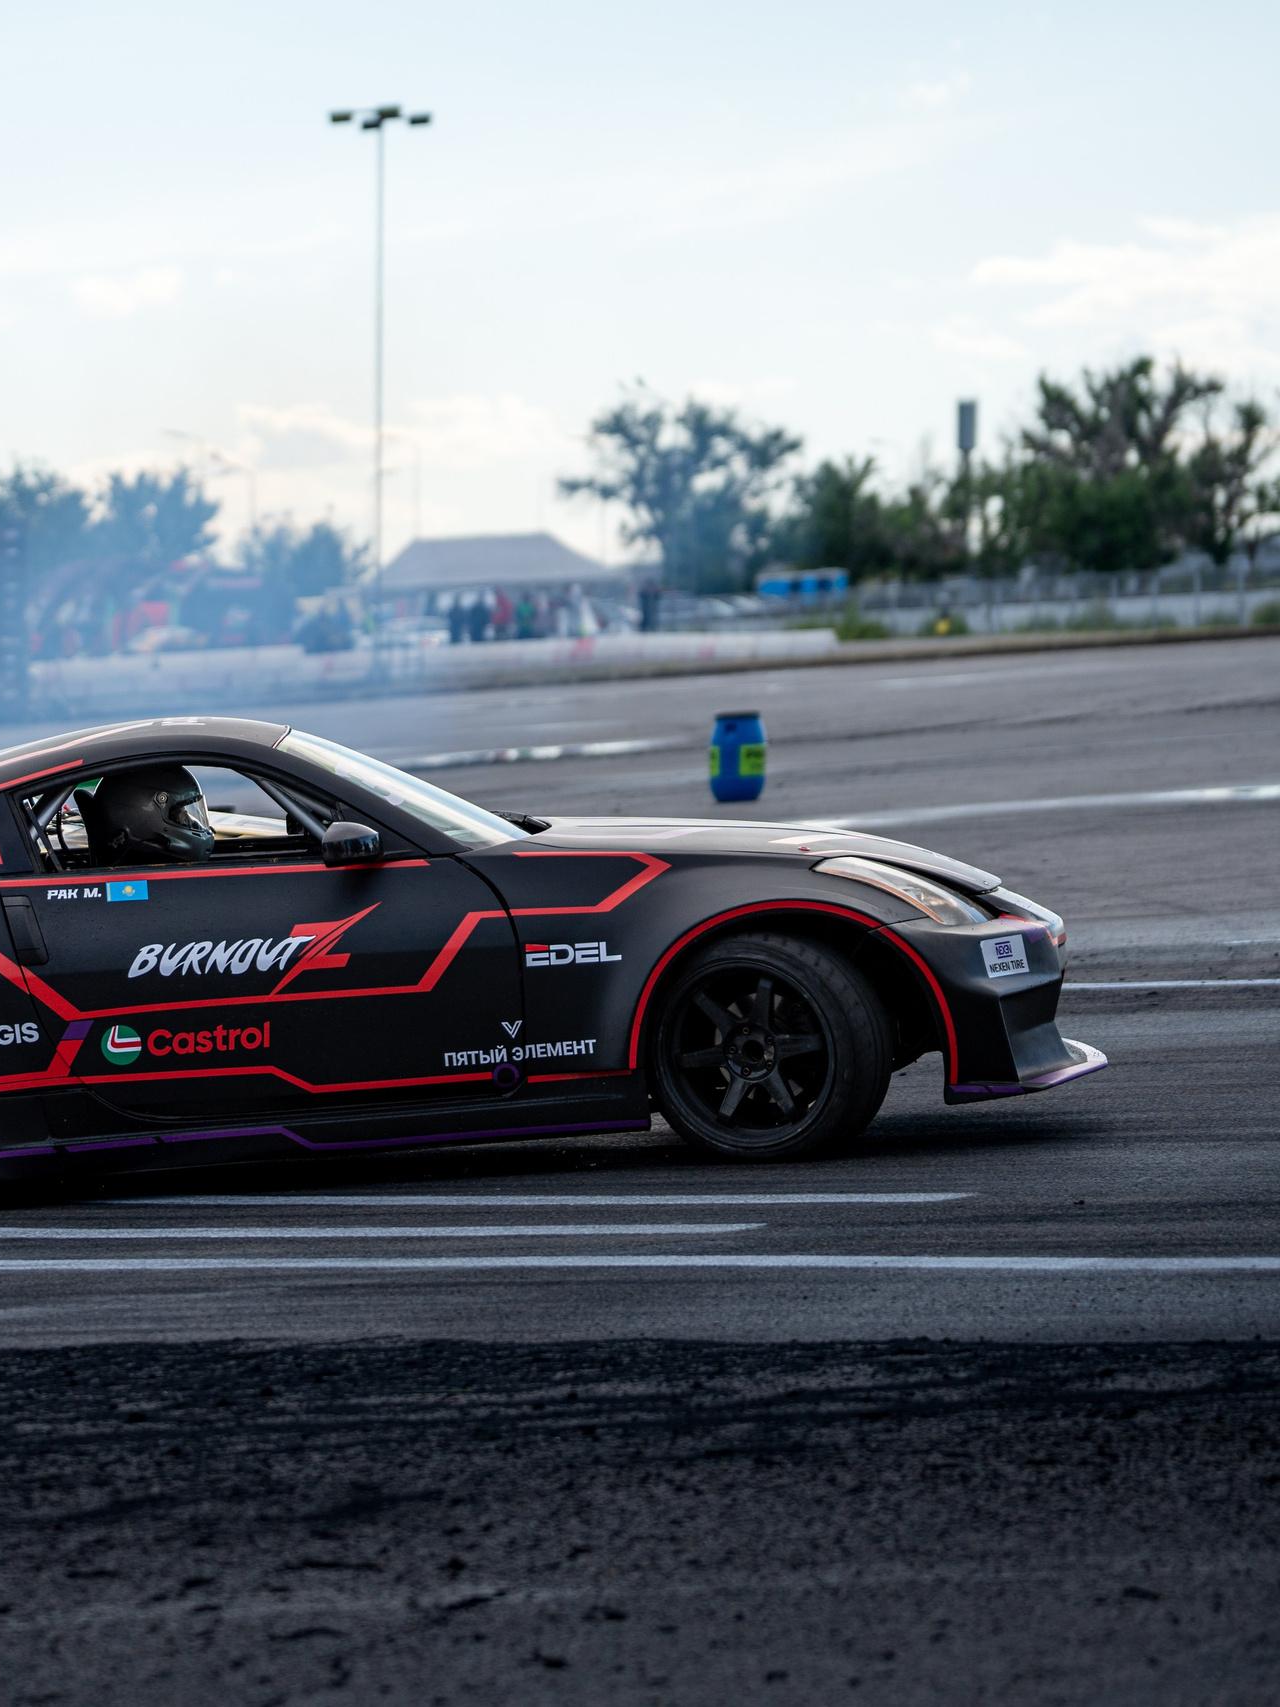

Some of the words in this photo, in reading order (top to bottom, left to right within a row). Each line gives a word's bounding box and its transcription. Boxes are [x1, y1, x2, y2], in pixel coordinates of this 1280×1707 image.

[47, 888, 79, 900] PAK
[83, 887, 102, 898] M.
[525, 941, 623, 967] EDEL
[989, 962, 1011, 973] NEXEN
[1010, 959, 1025, 970] TIRE
[147, 1020, 271, 1056] Castrol
[444, 1045, 508, 1067] ПЯТЫЙ
[512, 1039, 597, 1061] ЭЛЕМЕНТ
